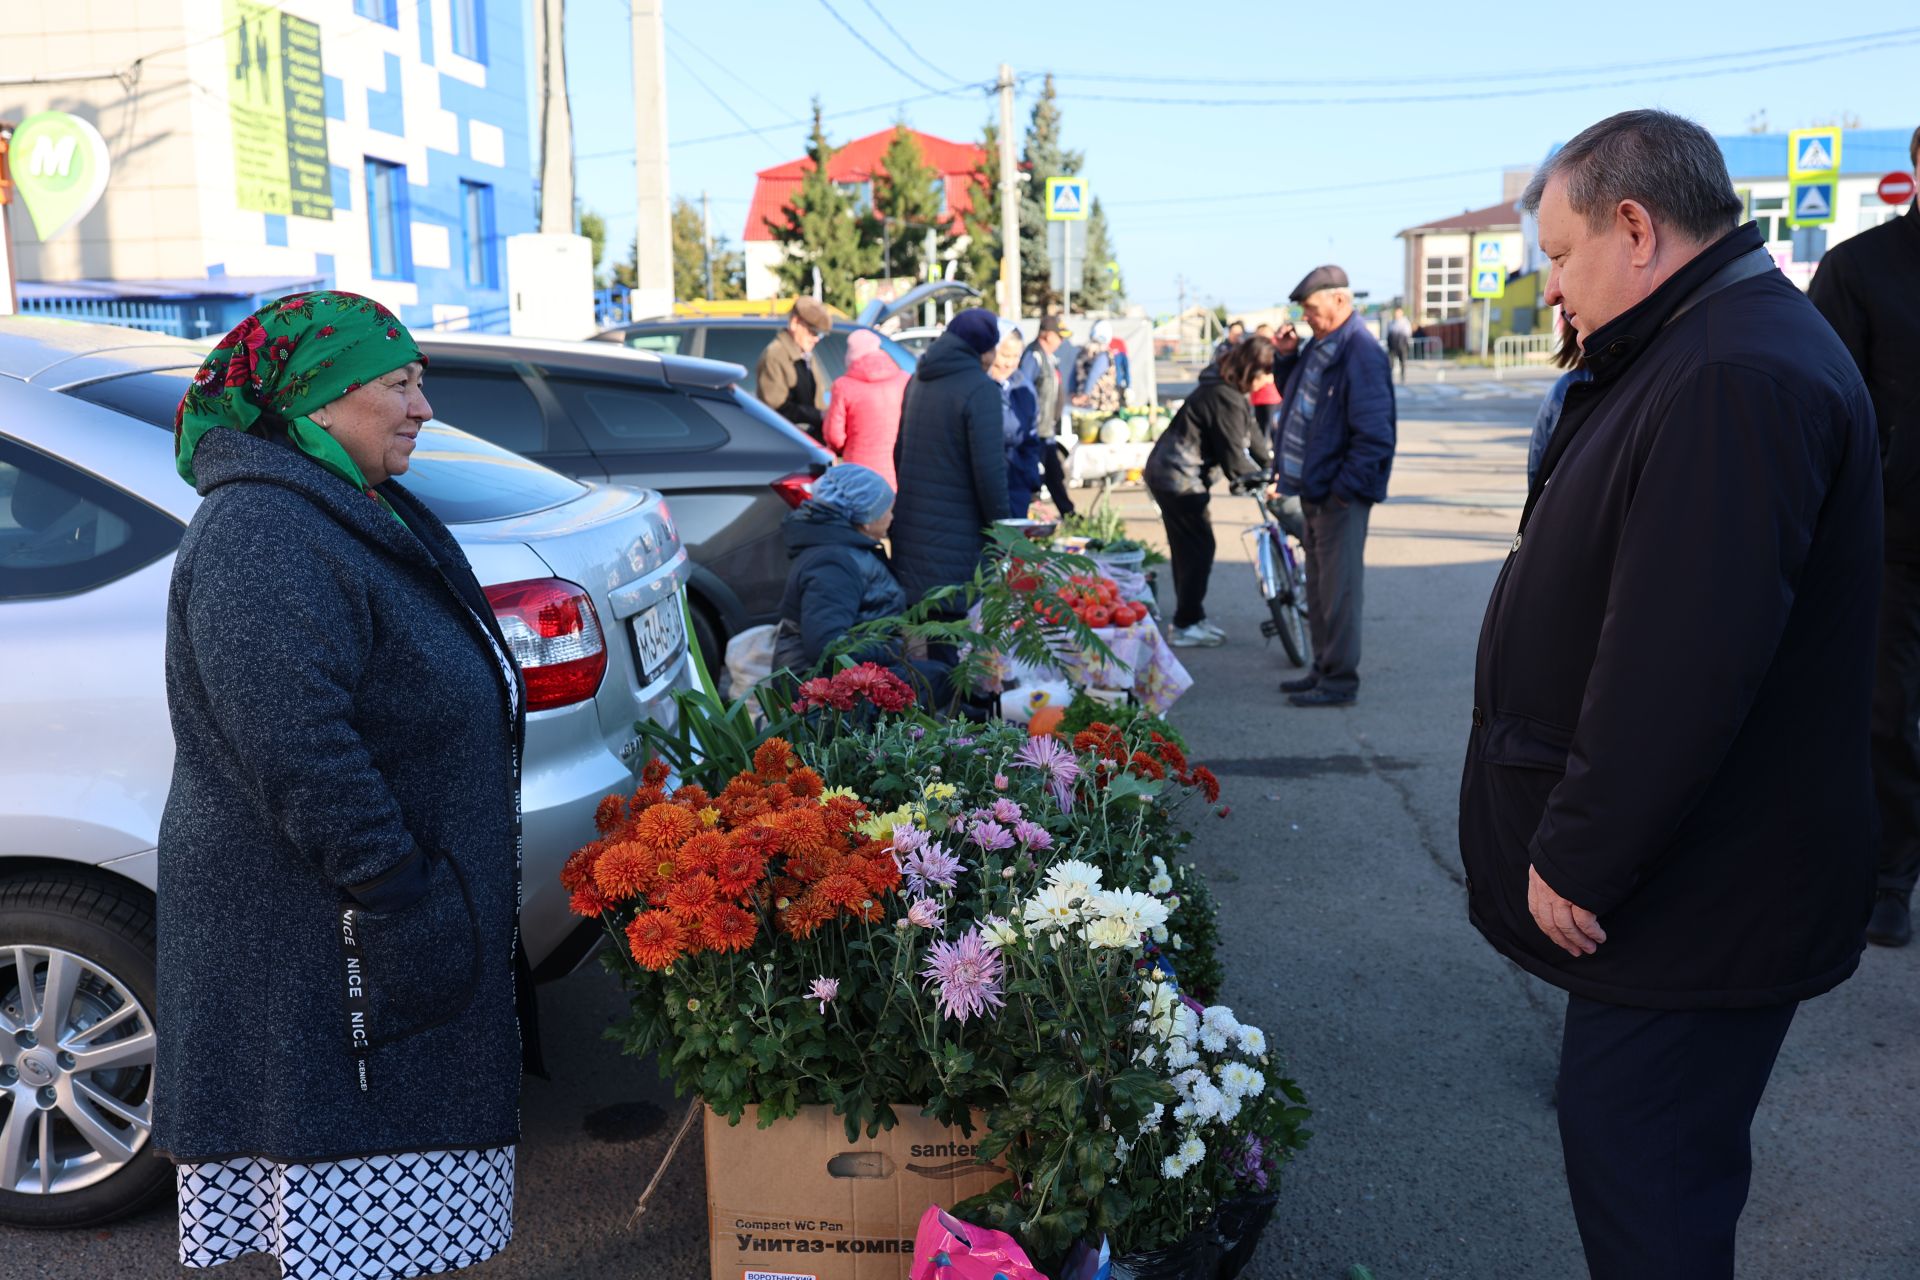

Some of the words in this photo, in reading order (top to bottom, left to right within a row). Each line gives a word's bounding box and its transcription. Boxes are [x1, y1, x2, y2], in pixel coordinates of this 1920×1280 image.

[342, 909, 356, 946] NICE
[347, 958, 362, 998] NICE
[735, 1219, 790, 1232] Compact
[794, 1220, 816, 1231] WC
[820, 1221, 843, 1232] Pan
